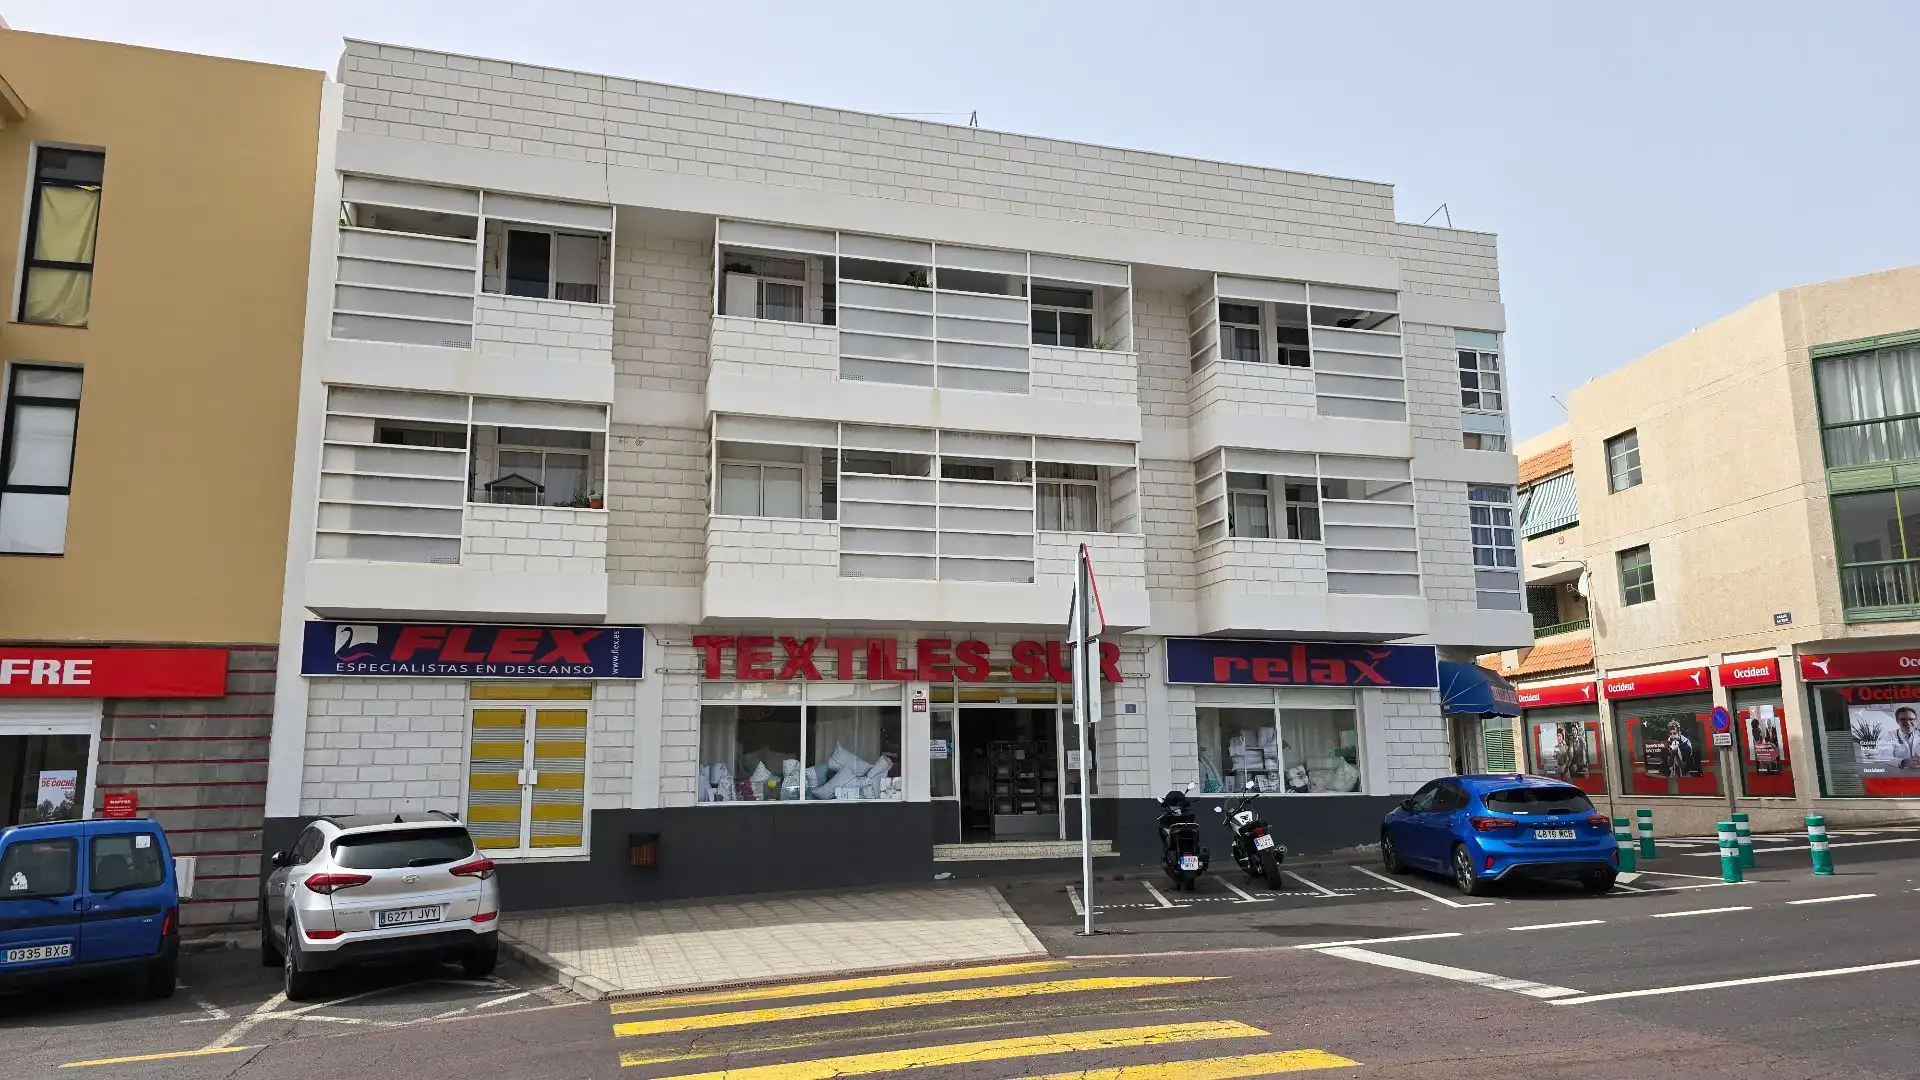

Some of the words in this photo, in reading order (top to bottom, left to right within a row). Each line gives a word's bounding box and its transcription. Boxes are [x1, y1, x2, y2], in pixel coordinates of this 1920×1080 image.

[390, 627, 604, 664] FLEX
[612, 630, 620, 675] www.flex.es
[692, 635, 990, 683] TEXTILES
[1009, 640, 1124, 683] SUR
[1213, 645, 1391, 684] relax
[0, 659, 93, 685] FRE
[336, 662, 468, 673] ESPECIALISTAS
[476, 664, 497, 674] EN
[504, 665, 594, 675] DESCANSO
[1733, 666, 1770, 679] Occident
[1607, 682, 1635, 692] Occident
[1518, 692, 1541, 703] Occident
[41, 780, 51, 788] DE
[51, 779, 75, 787] COCHE
[387, 910, 413, 922] 6271
[418, 908, 437, 919] JVY
[9, 948, 41, 961] 0335
[45, 945, 69, 958] BXG
